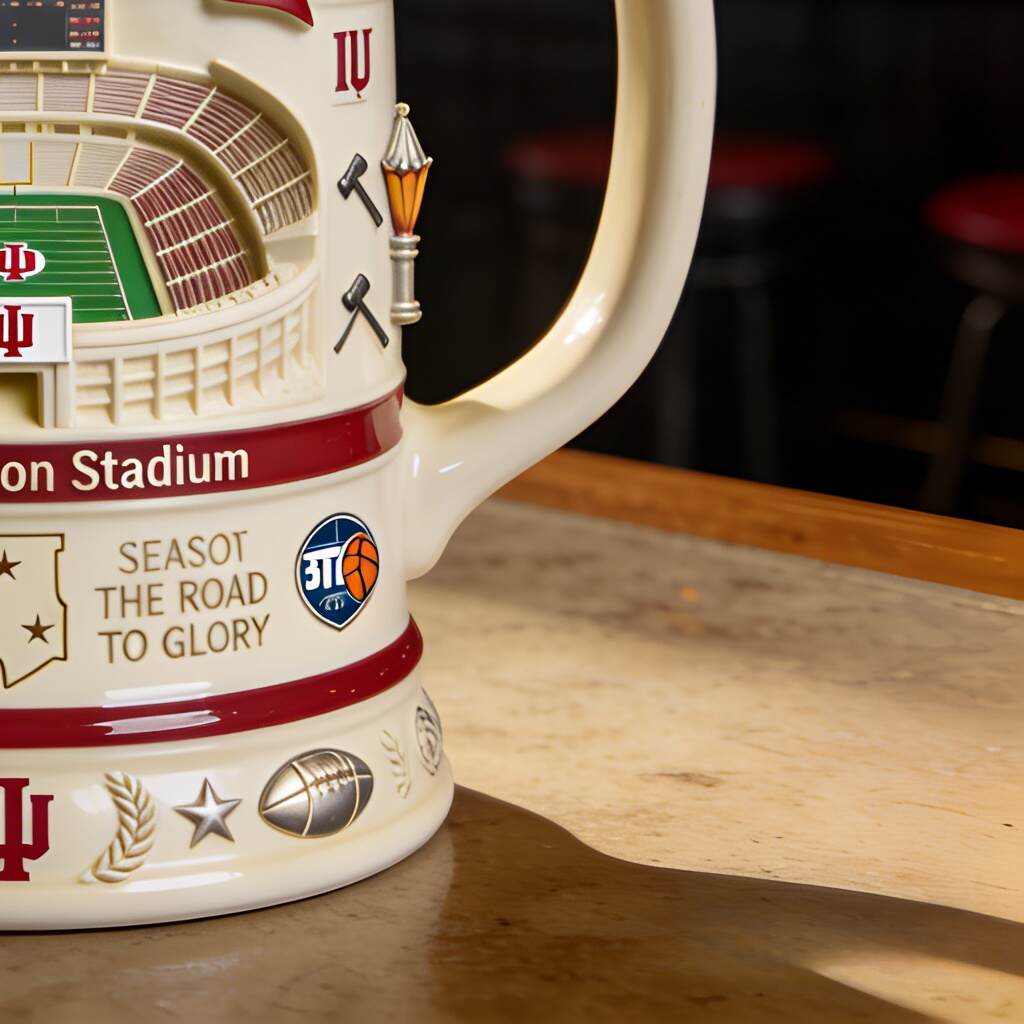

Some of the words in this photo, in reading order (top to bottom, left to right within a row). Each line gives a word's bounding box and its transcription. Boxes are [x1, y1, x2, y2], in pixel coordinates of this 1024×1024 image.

[333, 27, 373, 99] IU
[71, 444, 250, 491] Stadium
[118, 530, 248, 574] SEASOT
[94, 583, 165, 620] THE
[179, 571, 268, 614] ROAD
[97, 629, 148, 664] TO
[162, 613, 271, 659] GLORY
